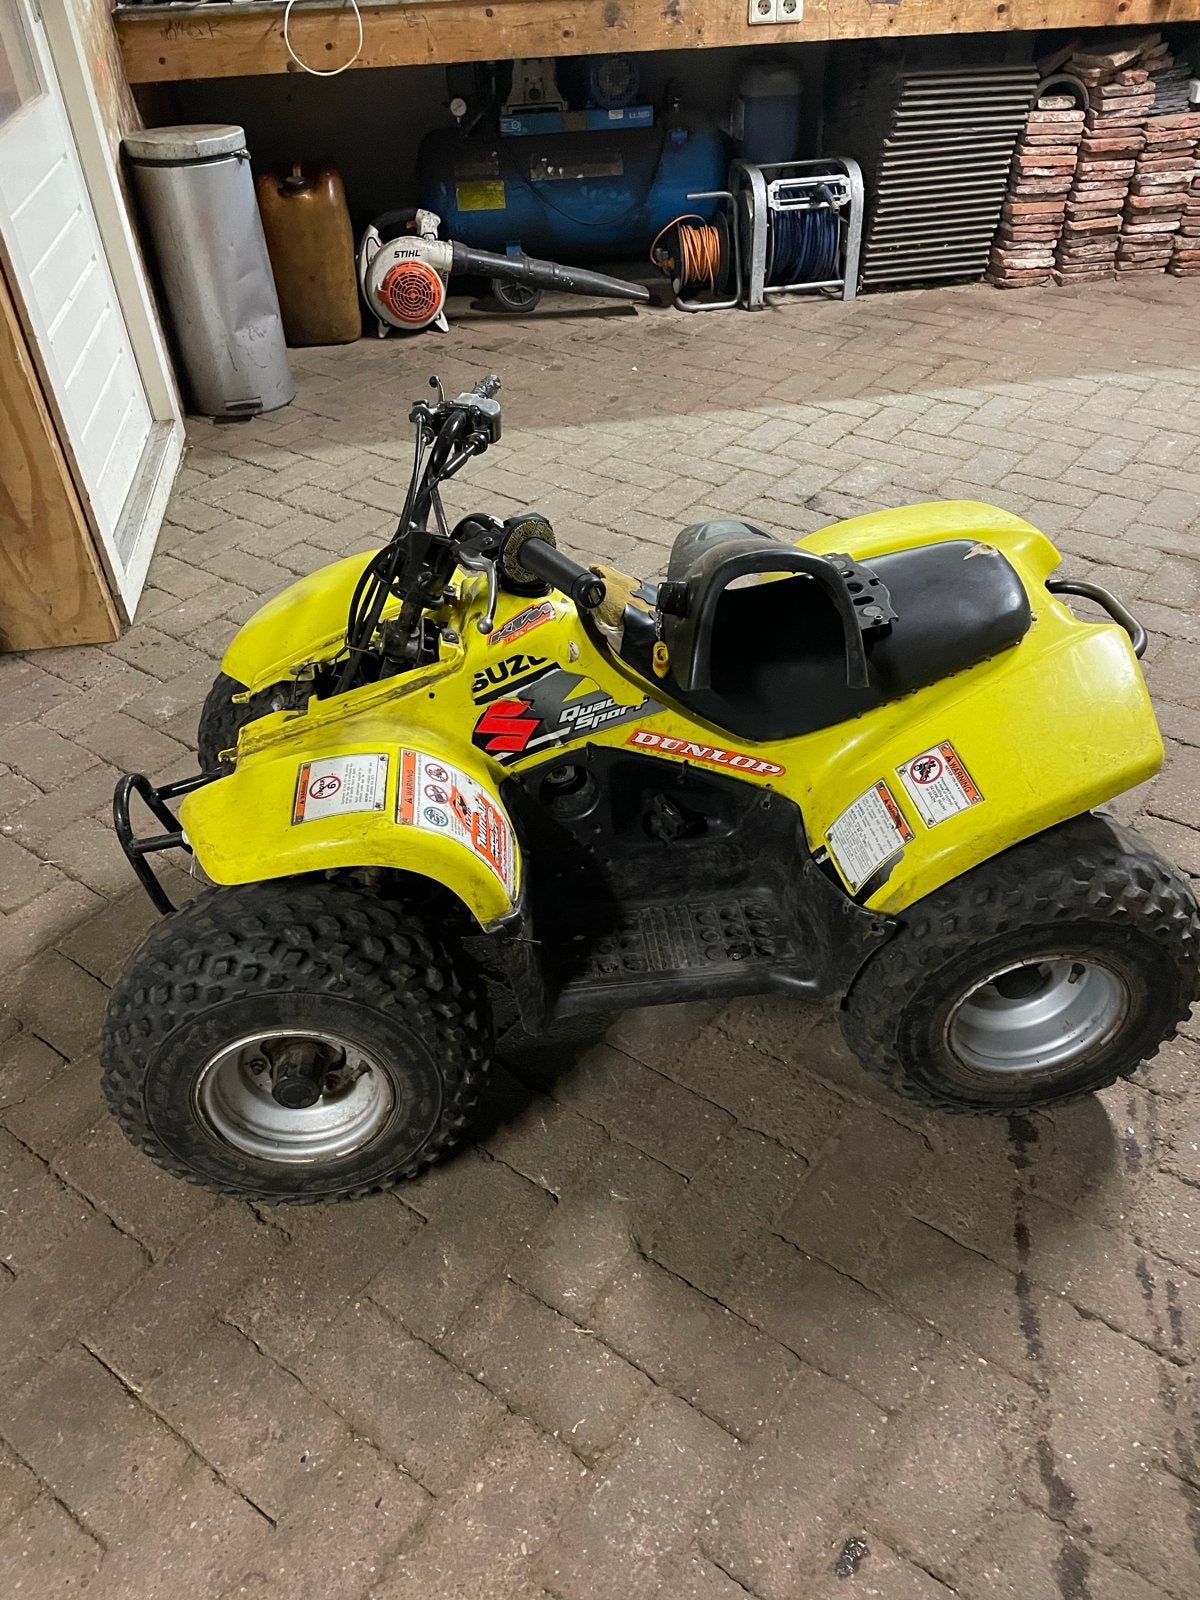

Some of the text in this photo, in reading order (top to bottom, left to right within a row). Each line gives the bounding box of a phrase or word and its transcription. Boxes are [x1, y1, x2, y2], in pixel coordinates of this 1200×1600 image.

[394, 250, 421, 258] STIHL
[631, 731, 781, 774] DUNLOP
[327, 782, 336, 790] 6
[949, 761, 972, 793] WARNING
